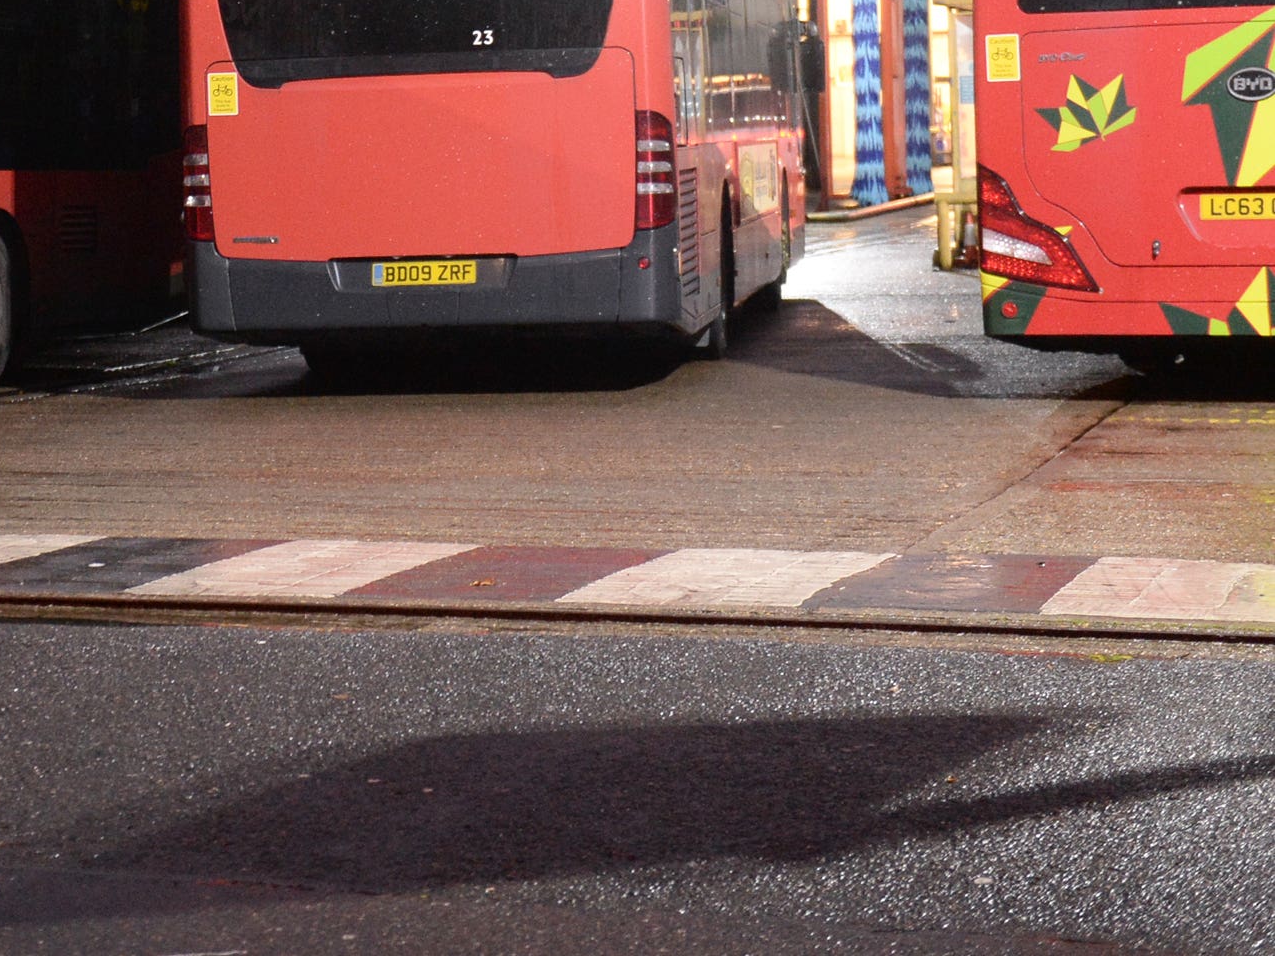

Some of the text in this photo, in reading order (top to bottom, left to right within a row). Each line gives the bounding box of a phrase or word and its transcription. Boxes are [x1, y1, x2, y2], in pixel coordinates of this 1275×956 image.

[472, 30, 494, 45] 23
[1233, 77, 1273, 91] BYD
[1210, 197, 1264, 216] LC63
[385, 264, 473, 282] BD09 ZRF
